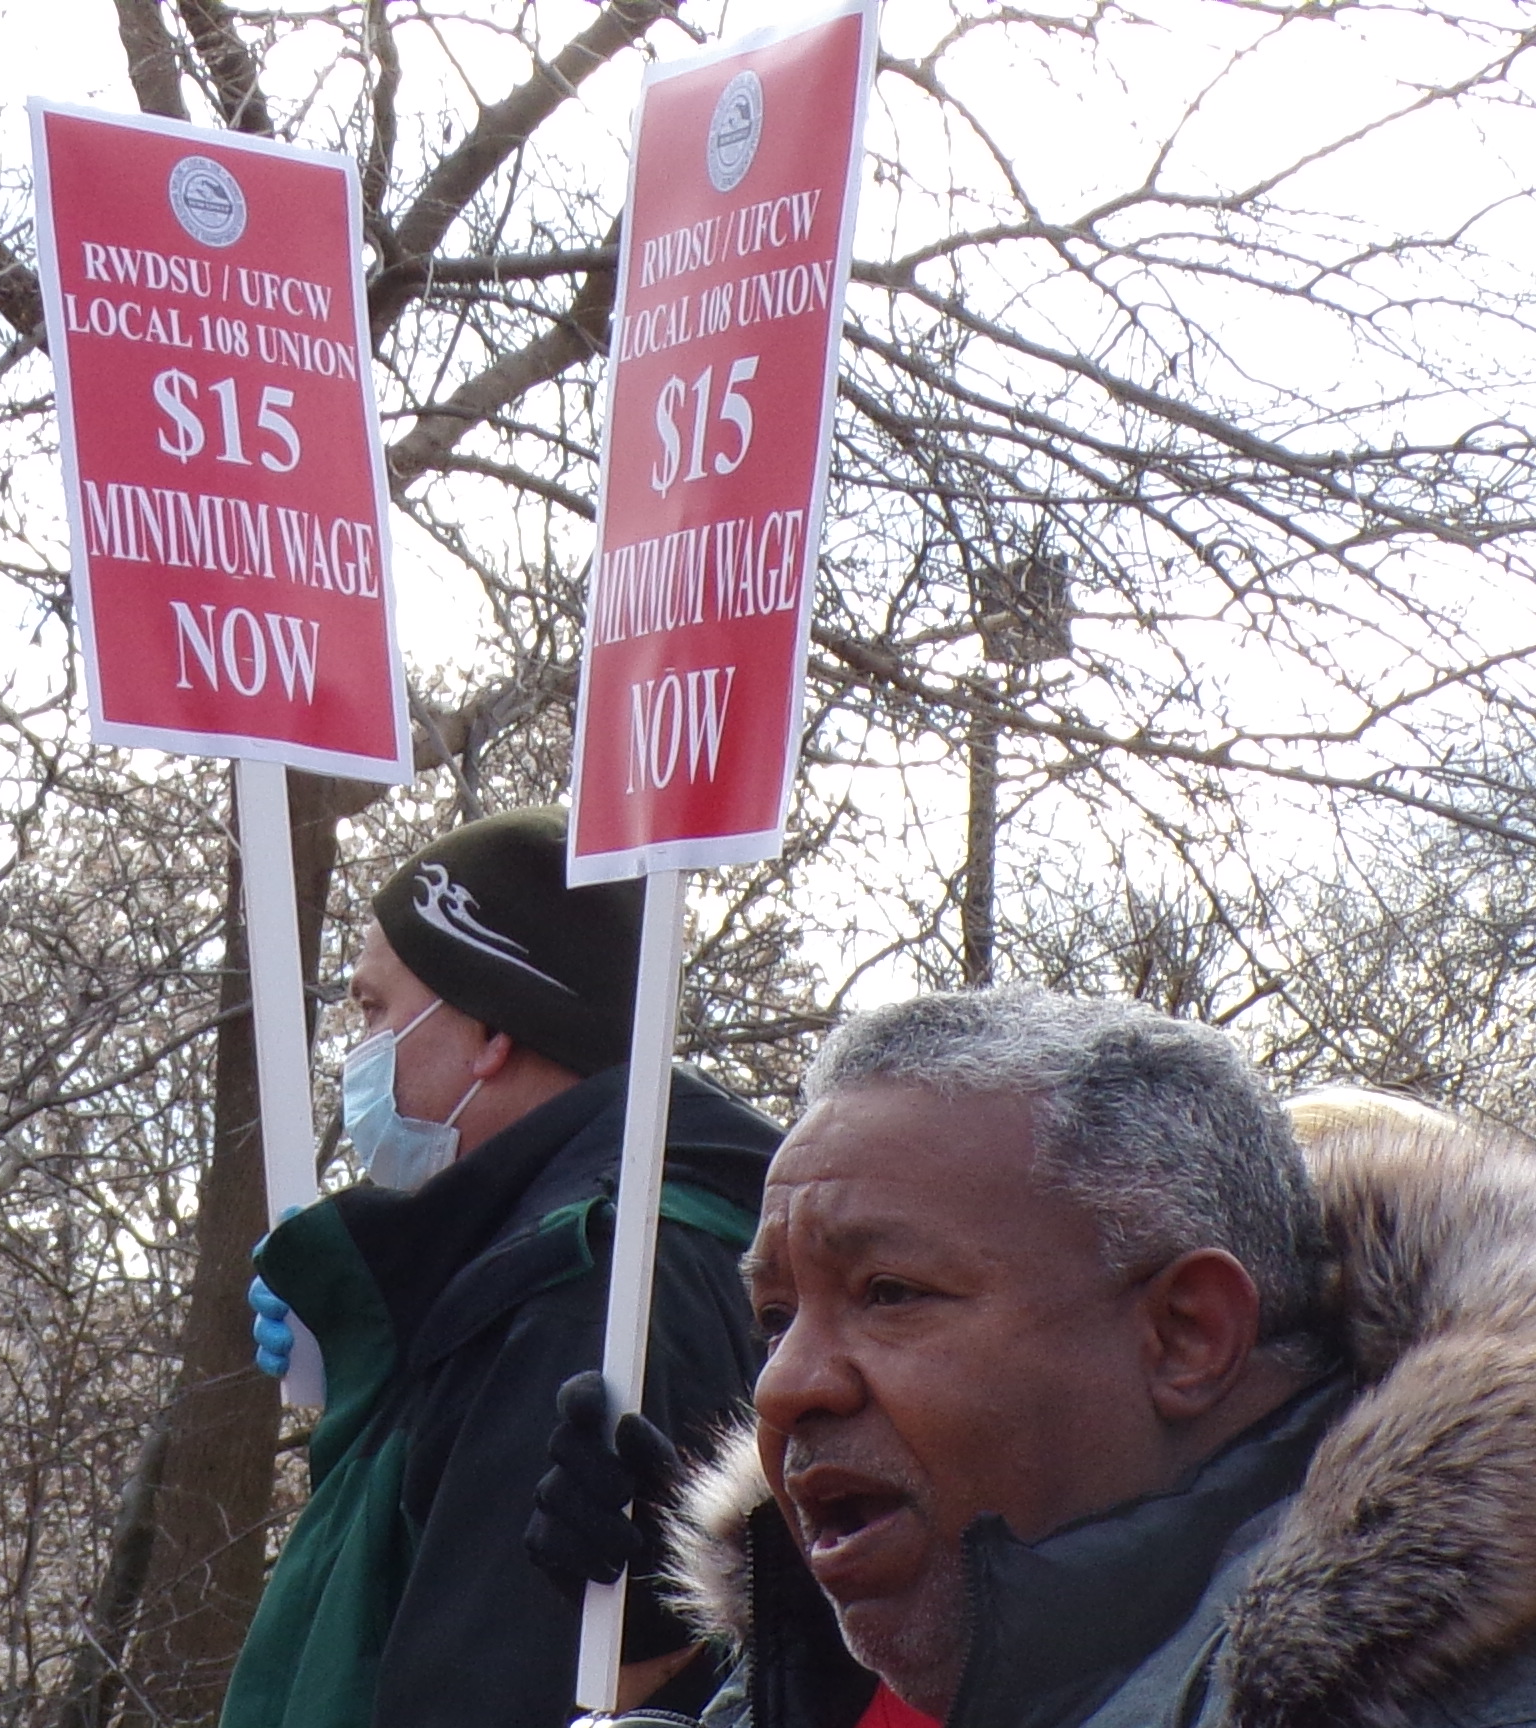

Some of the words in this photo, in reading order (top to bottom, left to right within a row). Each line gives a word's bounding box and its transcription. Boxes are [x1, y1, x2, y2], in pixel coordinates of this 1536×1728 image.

[81, 241, 213, 299] RWDSU
[221, 264, 231, 302] /
[237, 266, 333, 323] UFCW
[638, 216, 718, 290] RWDSU
[720, 211, 735, 263] /
[736, 189, 822, 258] UFCW
[64, 292, 193, 349] LOCAL
[198, 315, 250, 358] 108
[256, 324, 359, 382] UNION
[618, 296, 693, 364] LOCAL
[695, 284, 734, 340] 108
[736, 259, 835, 329] UNION
[152, 367, 302, 473] $15
[649, 354, 761, 499] $15
[82, 480, 277, 579] MINIMUM
[276, 506, 380, 599] WAGE
[593, 523, 711, 648] MINIMUM
[714, 508, 805, 623] WAGE
[168, 600, 321, 707] NOW
[625, 665, 737, 796] NOW
